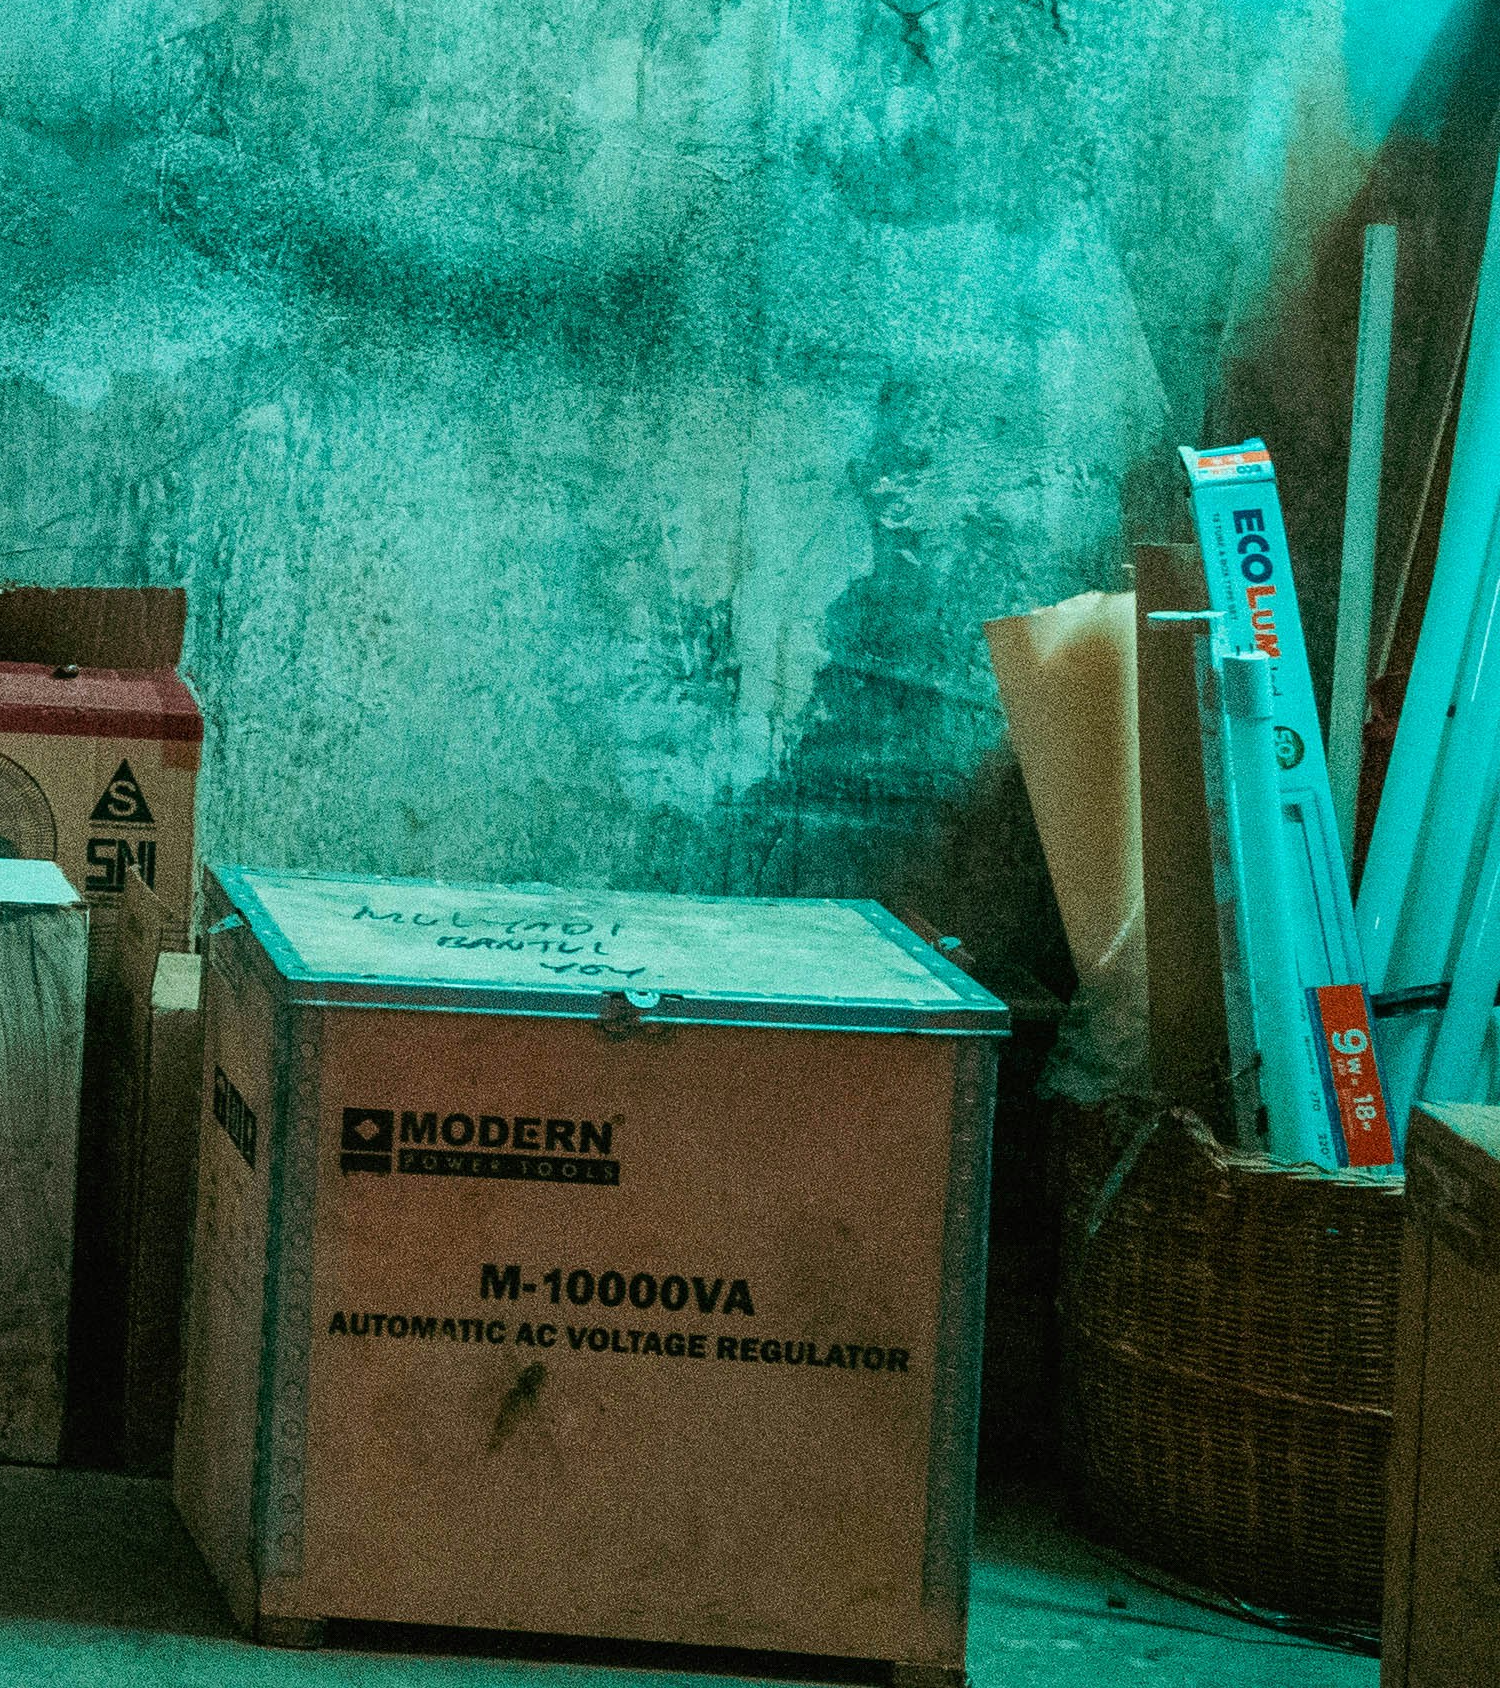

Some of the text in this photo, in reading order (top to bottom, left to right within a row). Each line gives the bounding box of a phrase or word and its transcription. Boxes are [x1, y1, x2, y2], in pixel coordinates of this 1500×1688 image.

[400, 1110, 613, 1155] MODERN
[403, 1154, 615, 1181] POWER TOOLS
[479, 1263, 755, 1317] M-10000VA
[328, 1310, 911, 1373] AUTOMATIC AC VOLTAGE REGULATOR
